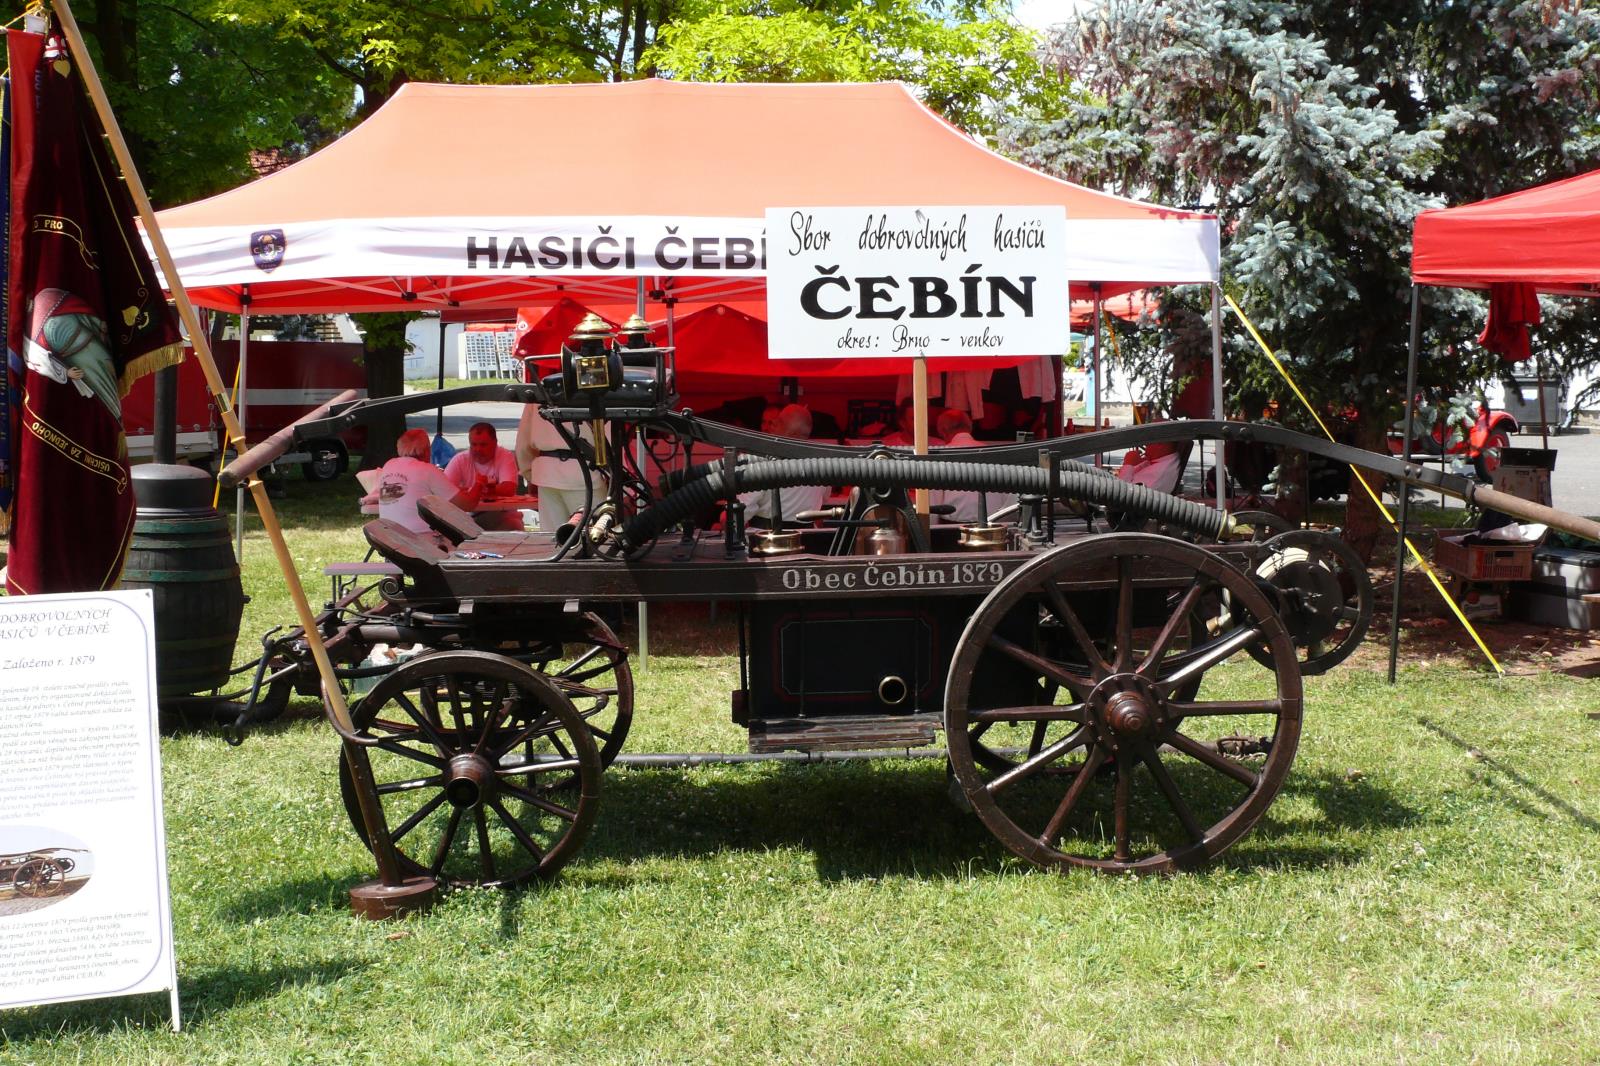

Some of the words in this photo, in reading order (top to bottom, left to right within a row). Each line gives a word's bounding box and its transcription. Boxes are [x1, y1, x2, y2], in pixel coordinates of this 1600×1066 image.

[44, 219, 63, 230] PRO
[789, 211, 831, 256] Sbor
[858, 213, 967, 261] dobrovolných
[994, 213, 1045, 252] hasičů
[466, 225, 636, 270] HASIČI
[800, 263, 1036, 321] ČEBÍN
[837, 327, 880, 349] okres:
[892, 324, 930, 352] Brno
[960, 327, 1004, 348] venkov
[70, 446, 83, 458] ZA
[782, 568, 856, 589] Obec
[863, 561, 945, 587] Čebín
[952, 562, 1004, 583] 1879
[2, 657, 54, 670] Založeno
[69, 654, 95, 667] 1879
